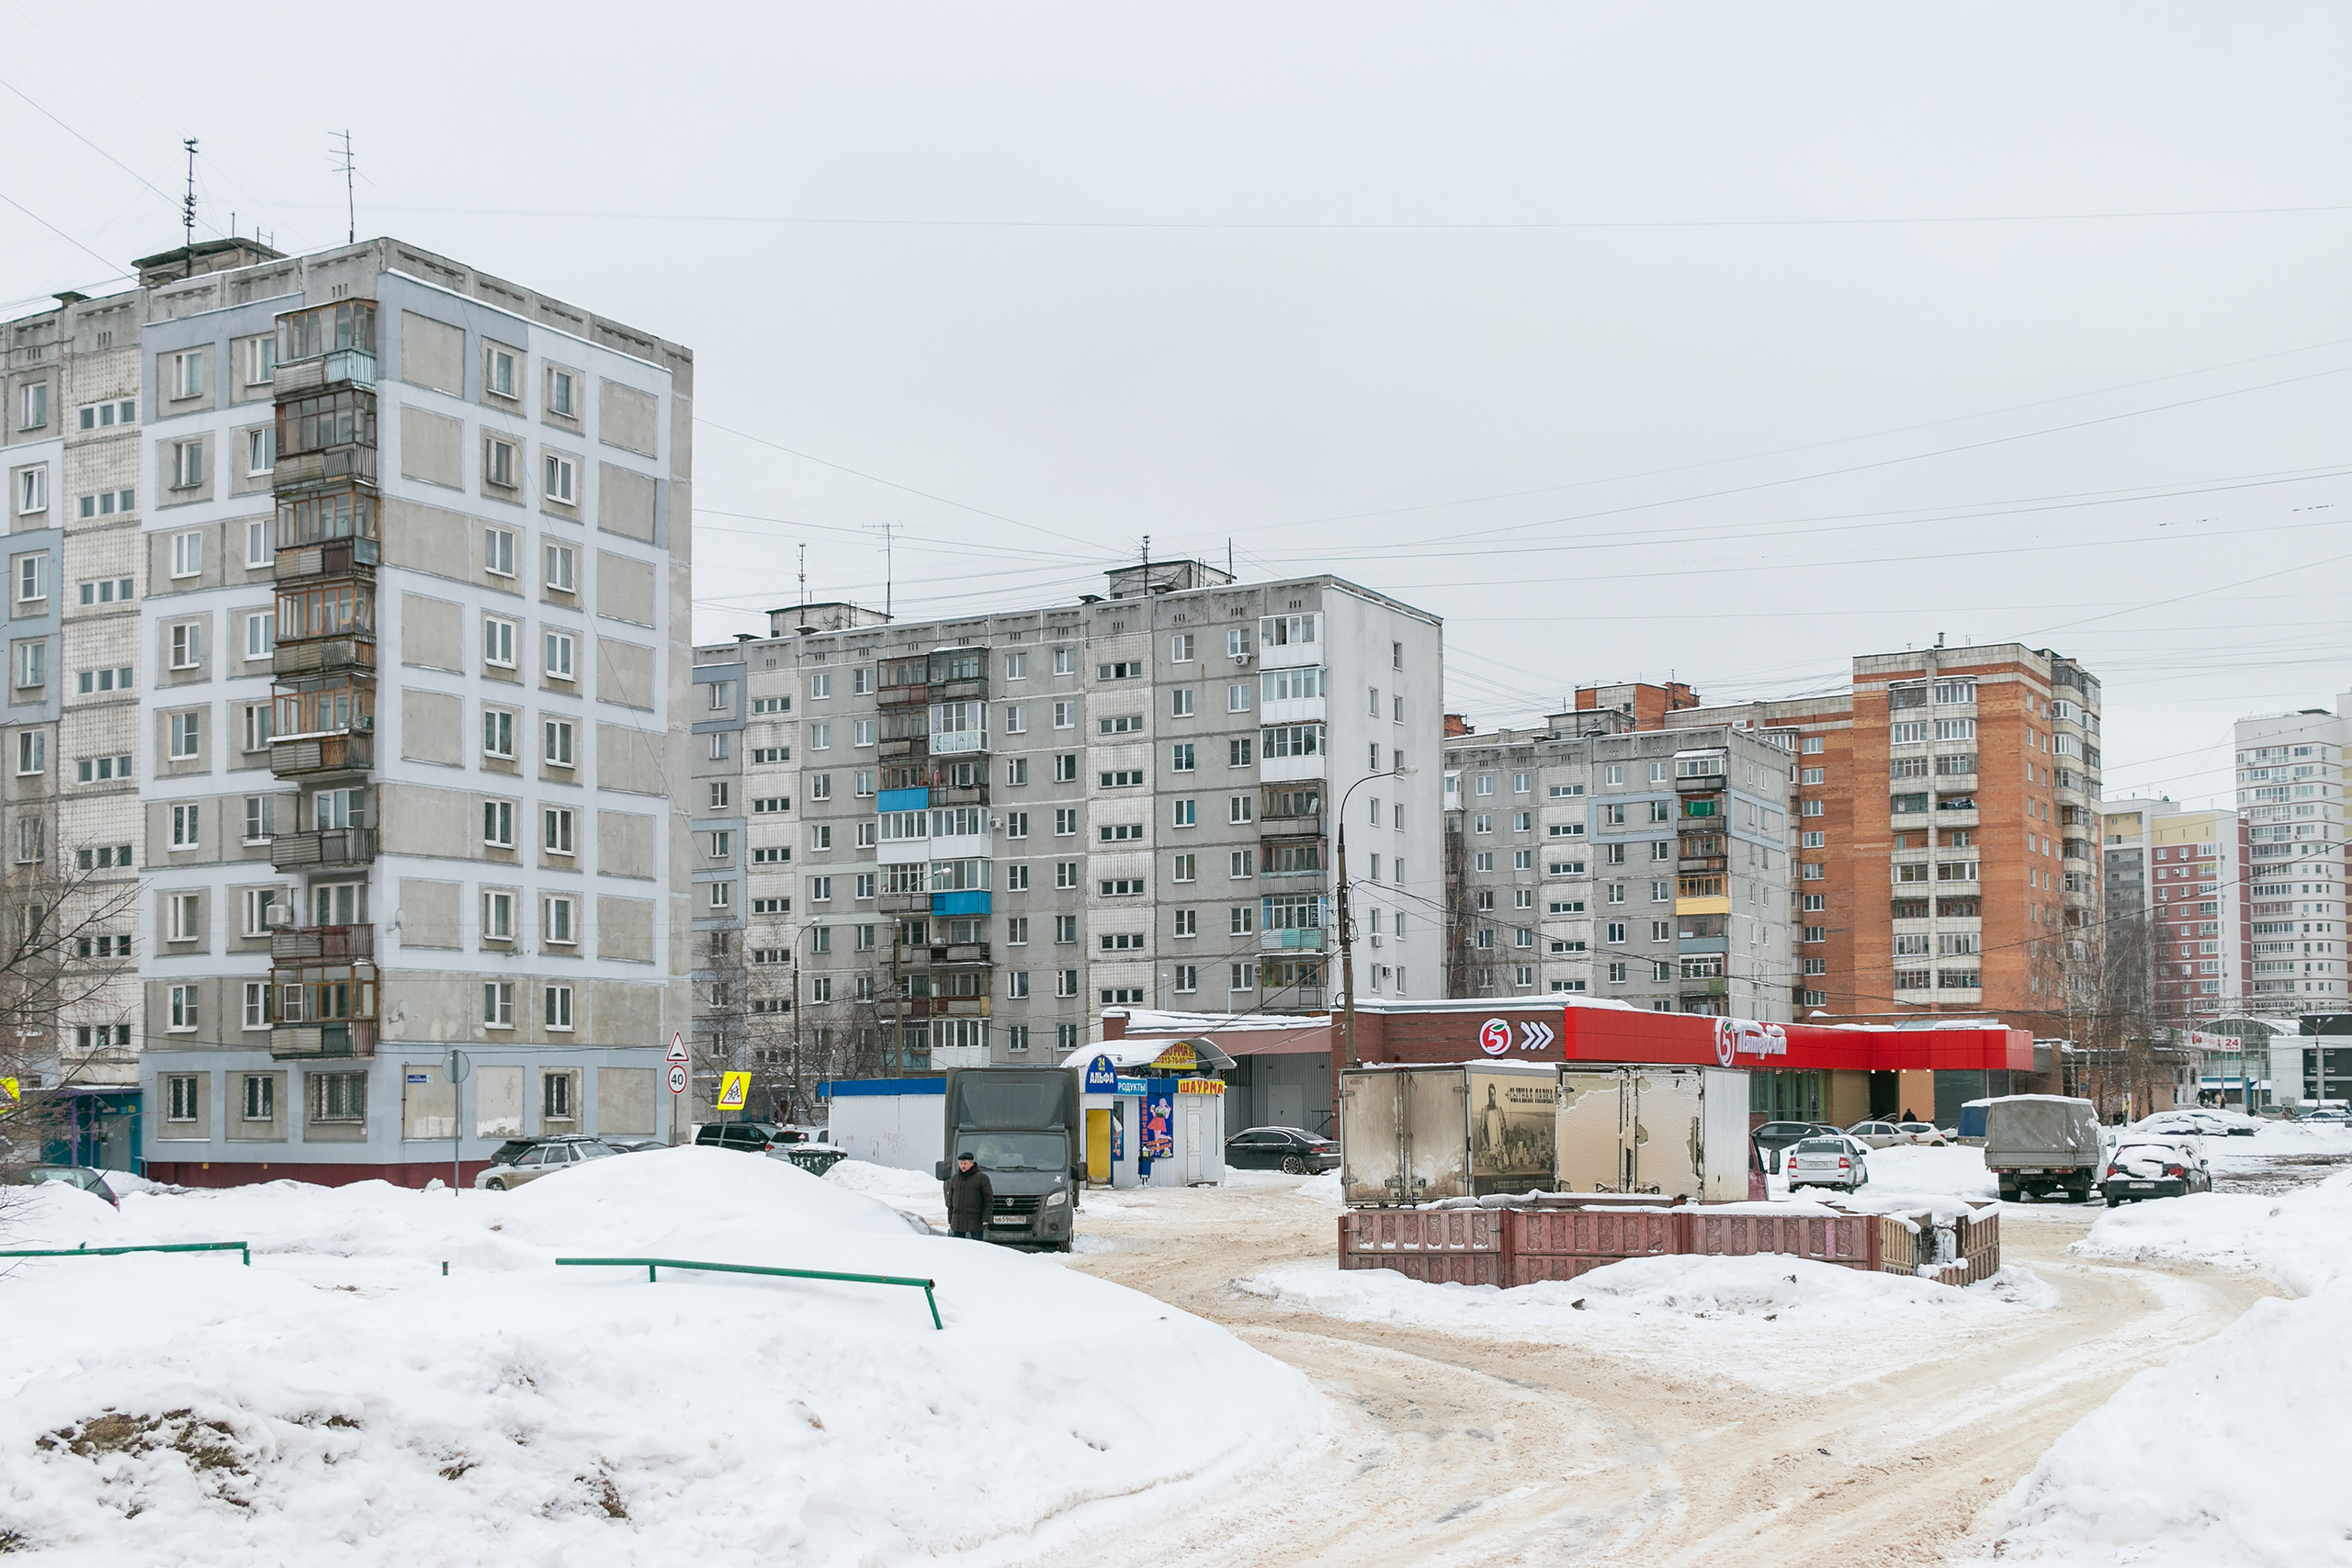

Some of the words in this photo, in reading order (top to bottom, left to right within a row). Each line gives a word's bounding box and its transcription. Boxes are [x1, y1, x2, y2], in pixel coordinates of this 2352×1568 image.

[2225, 1038, 2239, 1046] 24
[1159, 1042, 1188, 1057] АУРМА
[1097, 1057, 1106, 1067] 24
[671, 1074, 684, 1086] 40
[1089, 1072, 1114, 1084] АЛЬФА
[1117, 1082, 1146, 1093] РОДУКТЫ
[1180, 1080, 1224, 1094] ШАУРМА
[1510, 1087, 1533, 1103] СЫТНАЯ
[1534, 1088, 1555, 1104] ЛАВКА
